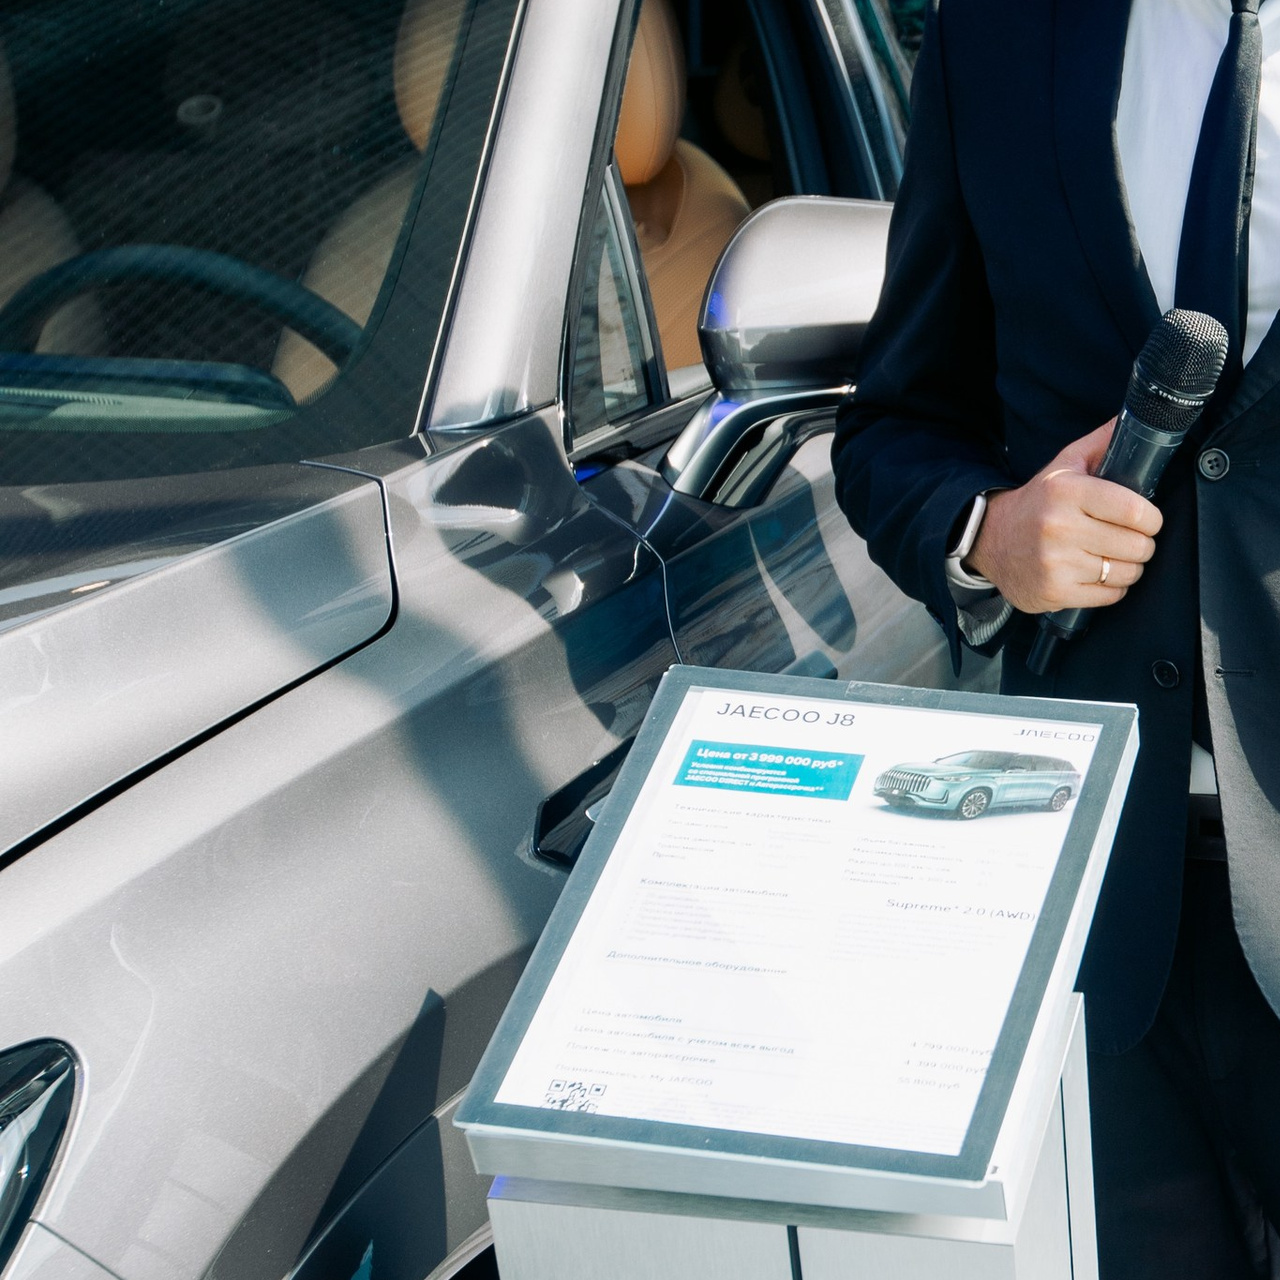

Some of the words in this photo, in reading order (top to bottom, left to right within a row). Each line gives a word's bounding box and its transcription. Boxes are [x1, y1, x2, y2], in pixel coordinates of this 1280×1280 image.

[717, 703, 820, 724] JAECOO
[826, 713, 856, 727] J8
[1013, 728, 1095, 742] JAECOO
[697, 748, 731, 760] Цена
[733, 752, 750, 761] от
[749, 753, 760, 762] 3
[759, 753, 784, 764] 999
[785, 756, 811, 767] 000
[685, 774, 719, 783] JAECOO
[607, 950, 702, 966] Дополнительное
[705, 960, 788, 975] оборудование
